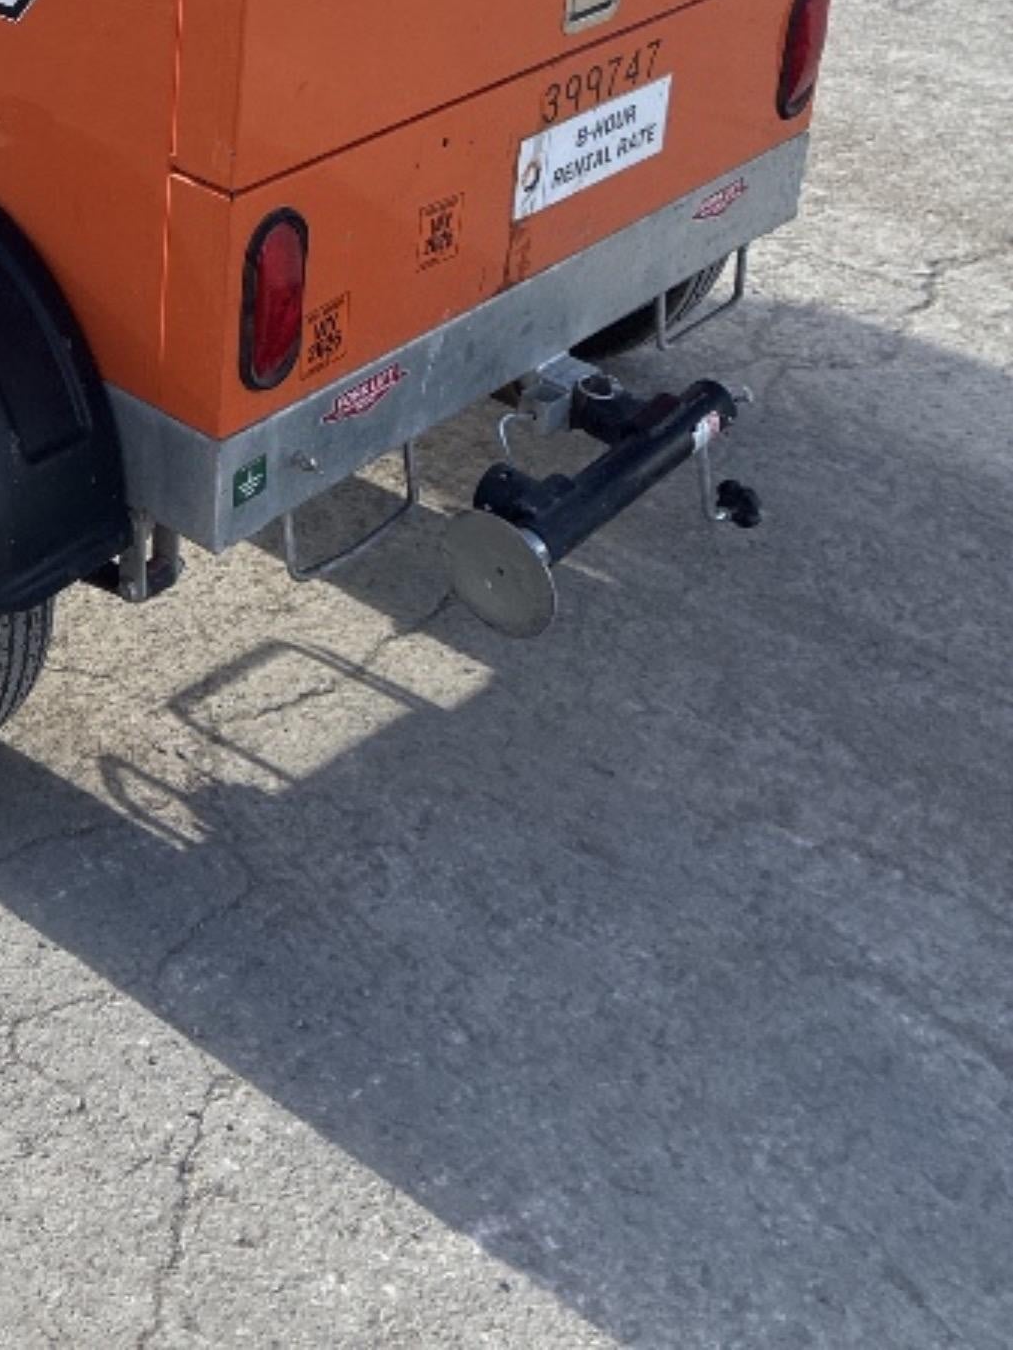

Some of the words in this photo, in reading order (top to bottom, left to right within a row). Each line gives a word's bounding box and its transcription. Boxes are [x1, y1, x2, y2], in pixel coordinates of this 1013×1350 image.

[541, 38, 663, 124] 399747
[551, 145, 613, 190] RENTAL
[616, 122, 658, 158] RATE
